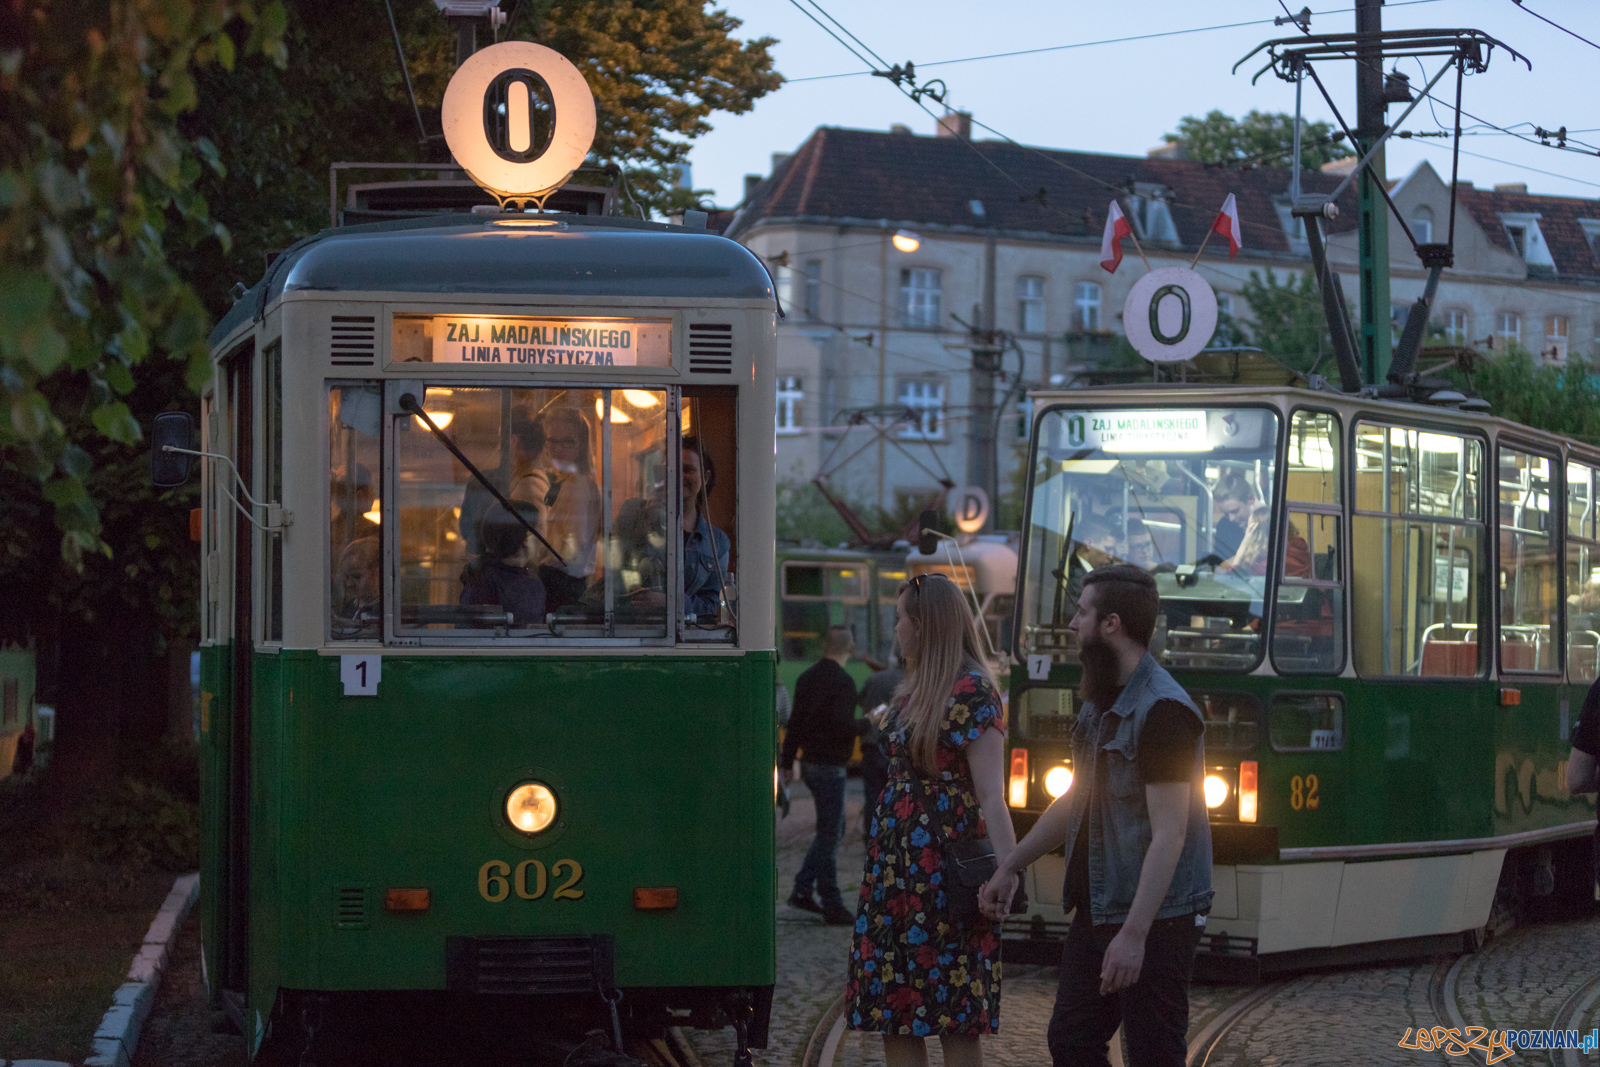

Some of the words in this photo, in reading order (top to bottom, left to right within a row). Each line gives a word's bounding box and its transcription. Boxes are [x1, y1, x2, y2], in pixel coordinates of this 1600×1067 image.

[483, 67, 557, 164] 0
[1149, 284, 1191, 345] 0
[446, 322, 485, 343] ZAJ.
[491, 324, 631, 349] MADALIŃSKIEGO
[462, 345, 502, 363] LINIA
[507, 347, 614, 366] TURYSTYCZNA
[963, 494, 982, 522] D
[355, 660, 367, 688] 1
[1035, 659, 1043, 674] 1
[1290, 773, 1320, 811] 82
[478, 858, 585, 903] 602
